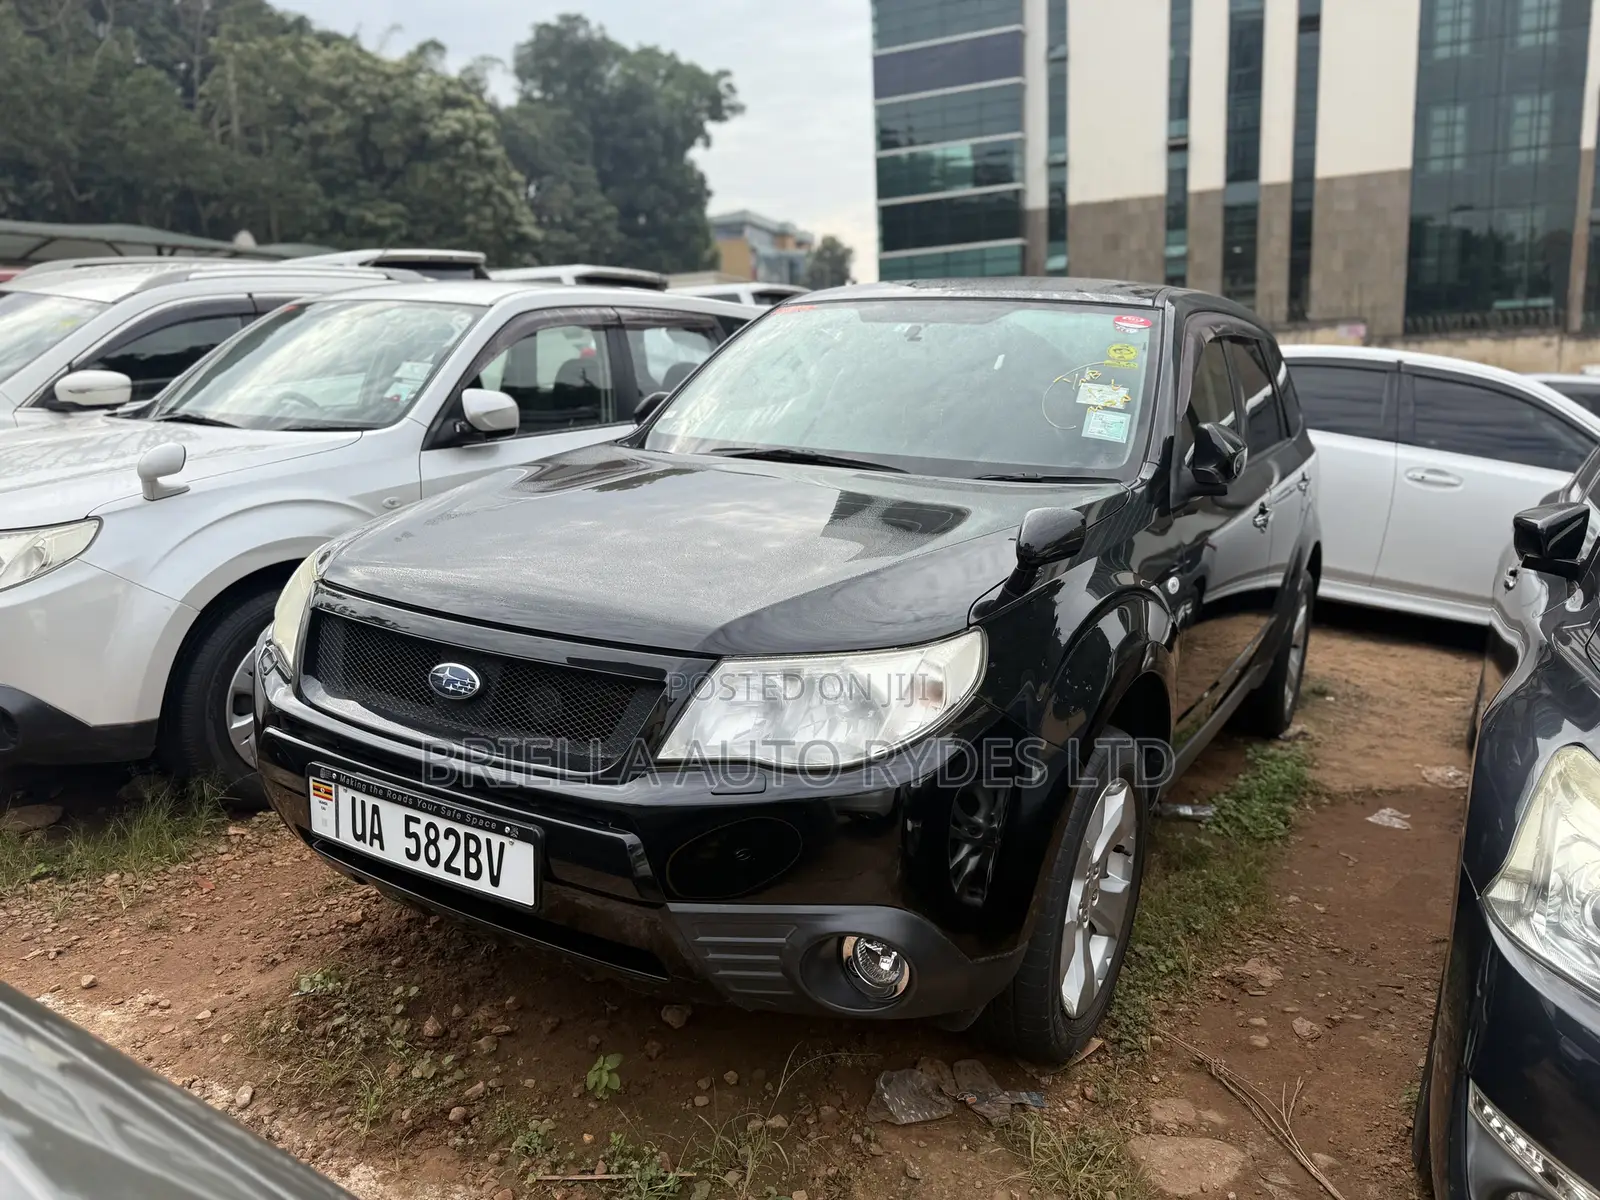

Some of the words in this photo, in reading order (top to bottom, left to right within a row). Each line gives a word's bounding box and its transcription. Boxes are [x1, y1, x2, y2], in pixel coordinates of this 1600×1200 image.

[340, 774, 367, 792] Making
[369, 785, 384, 796] the
[386, 790, 413, 805] Roads
[417, 798, 438, 812] Your
[440, 806, 462, 820] Safe
[465, 813, 497, 830] Space
[351, 795, 385, 851] UA
[404, 813, 506, 888] 582BV
